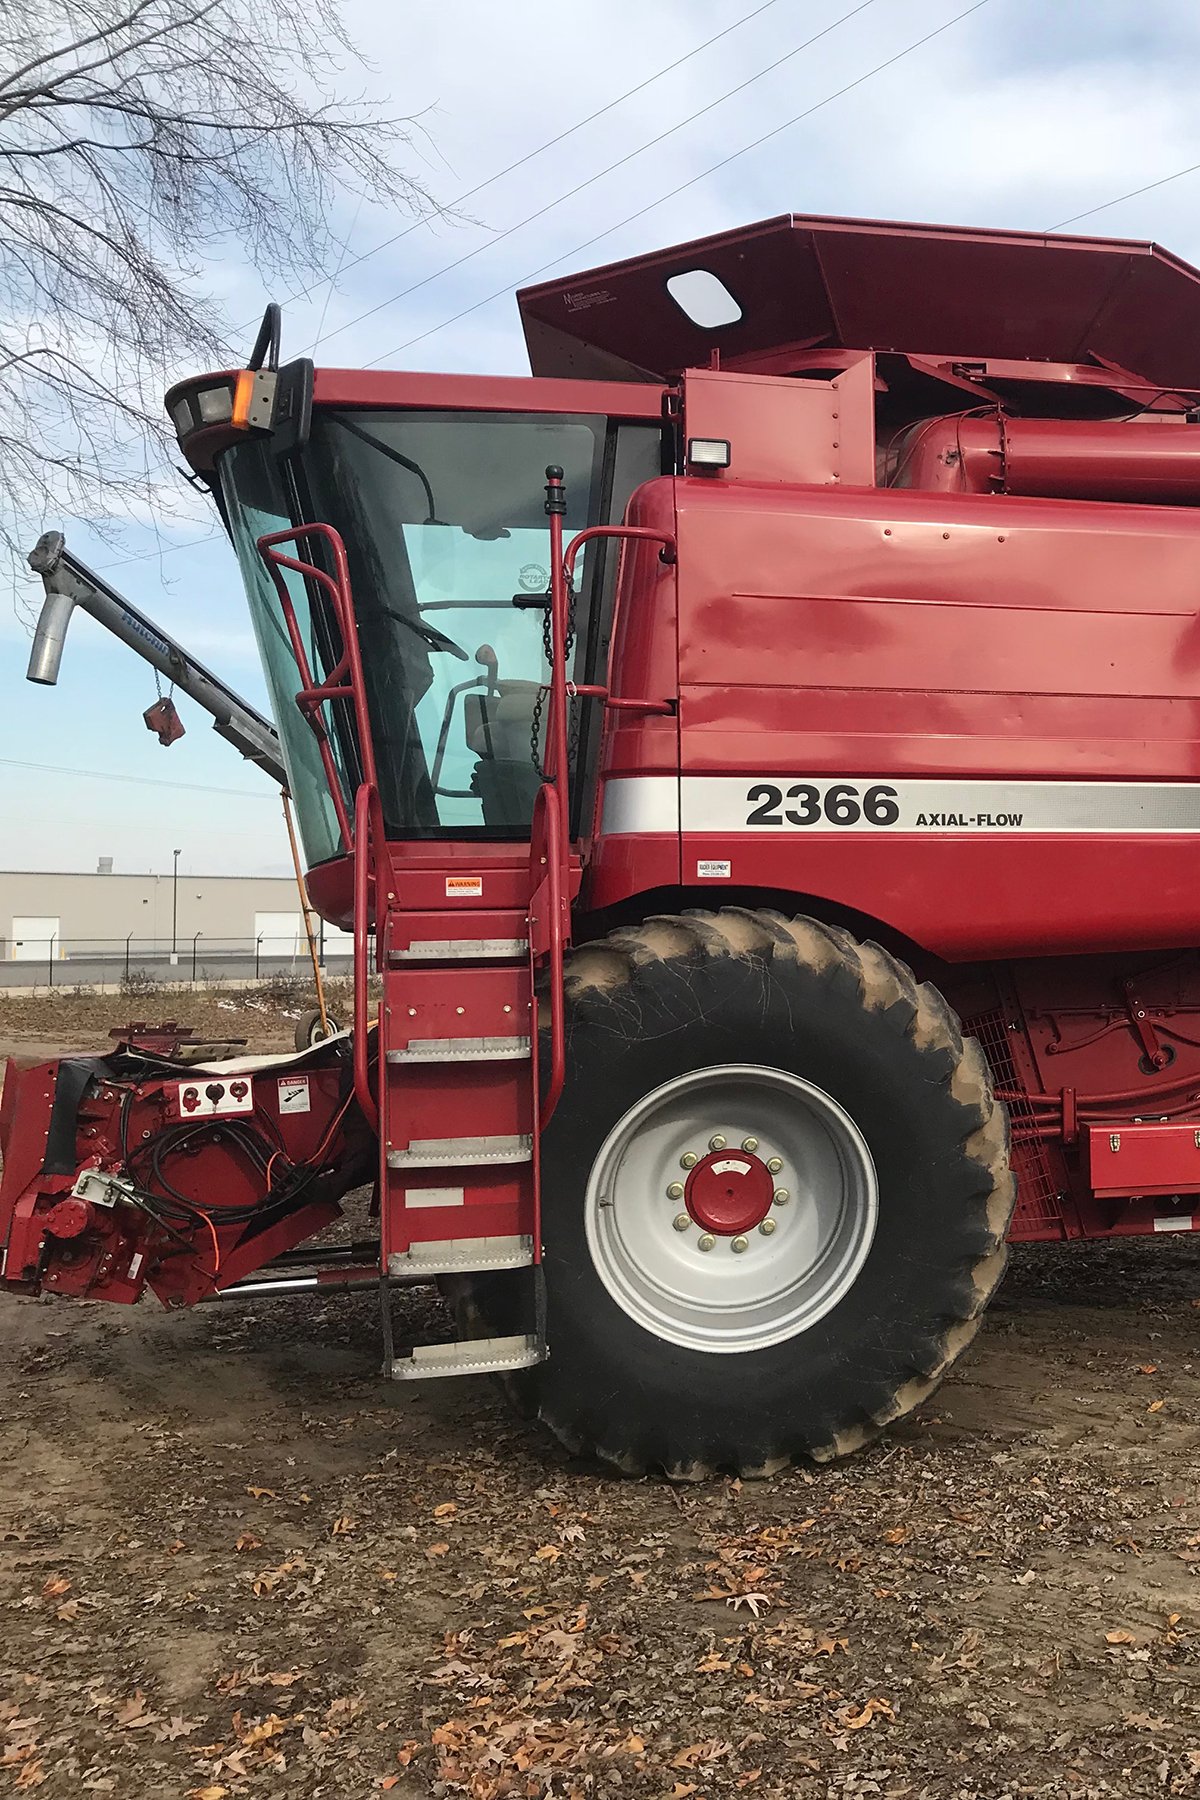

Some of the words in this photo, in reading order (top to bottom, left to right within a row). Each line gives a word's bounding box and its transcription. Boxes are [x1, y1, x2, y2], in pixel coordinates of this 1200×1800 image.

[745, 784, 900, 827] 2366
[916, 813, 1024, 827] AXIAL-FLOW
[454, 880, 481, 888] WARNING
[286, 1079, 307, 1087] DANGER
